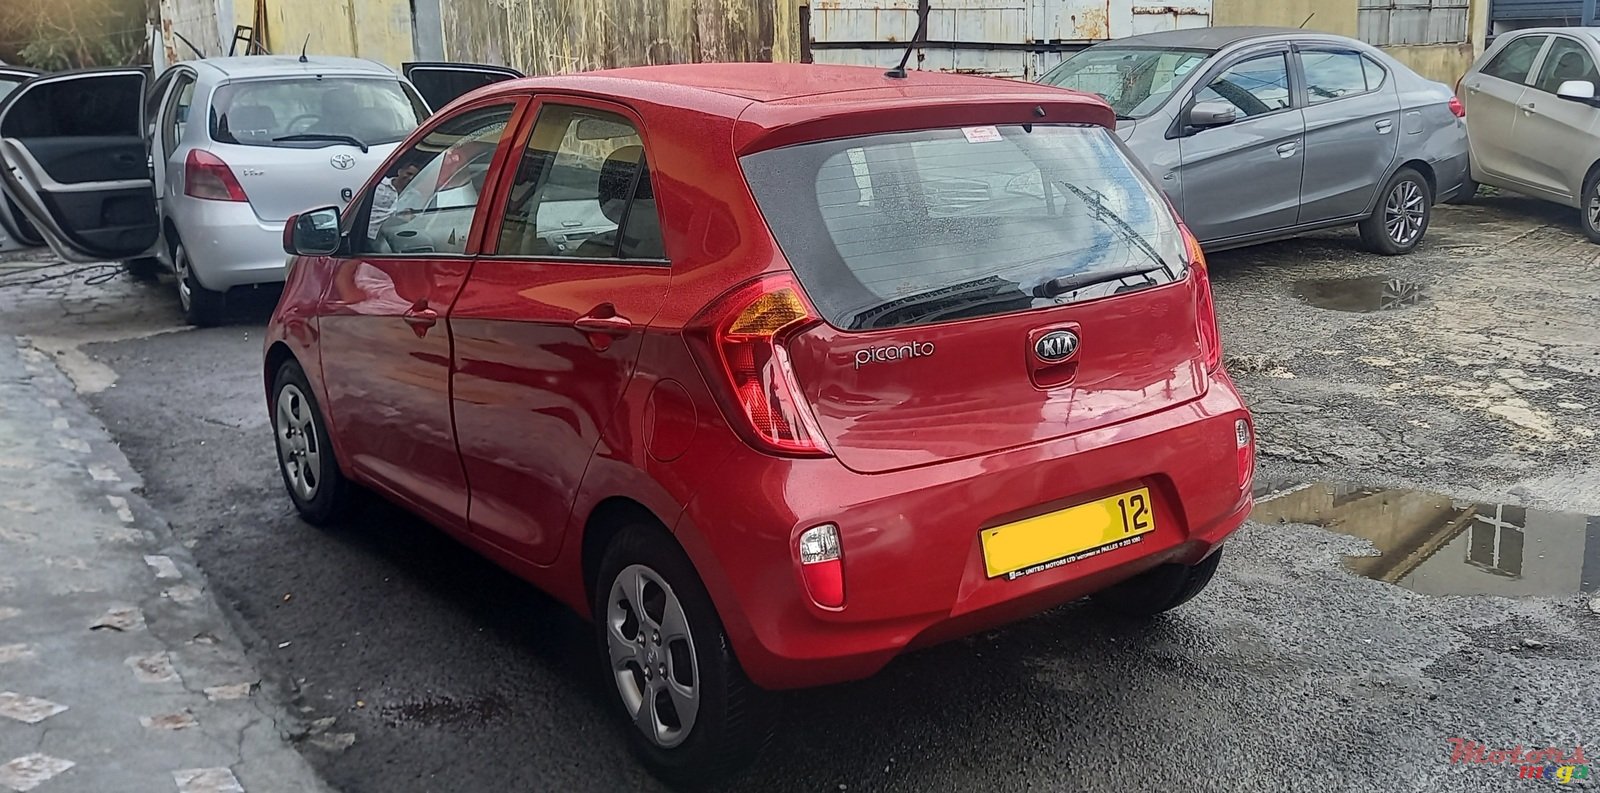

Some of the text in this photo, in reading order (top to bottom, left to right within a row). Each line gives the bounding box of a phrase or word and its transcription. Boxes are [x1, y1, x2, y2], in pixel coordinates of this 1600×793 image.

[855, 340, 935, 370] picanto
[1043, 336, 1073, 357] KIA
[1117, 494, 1148, 533] 12
[1025, 565, 1045, 576] UNITED
[1045, 558, 1067, 570] MOTORS
[1066, 555, 1076, 564] LTD
